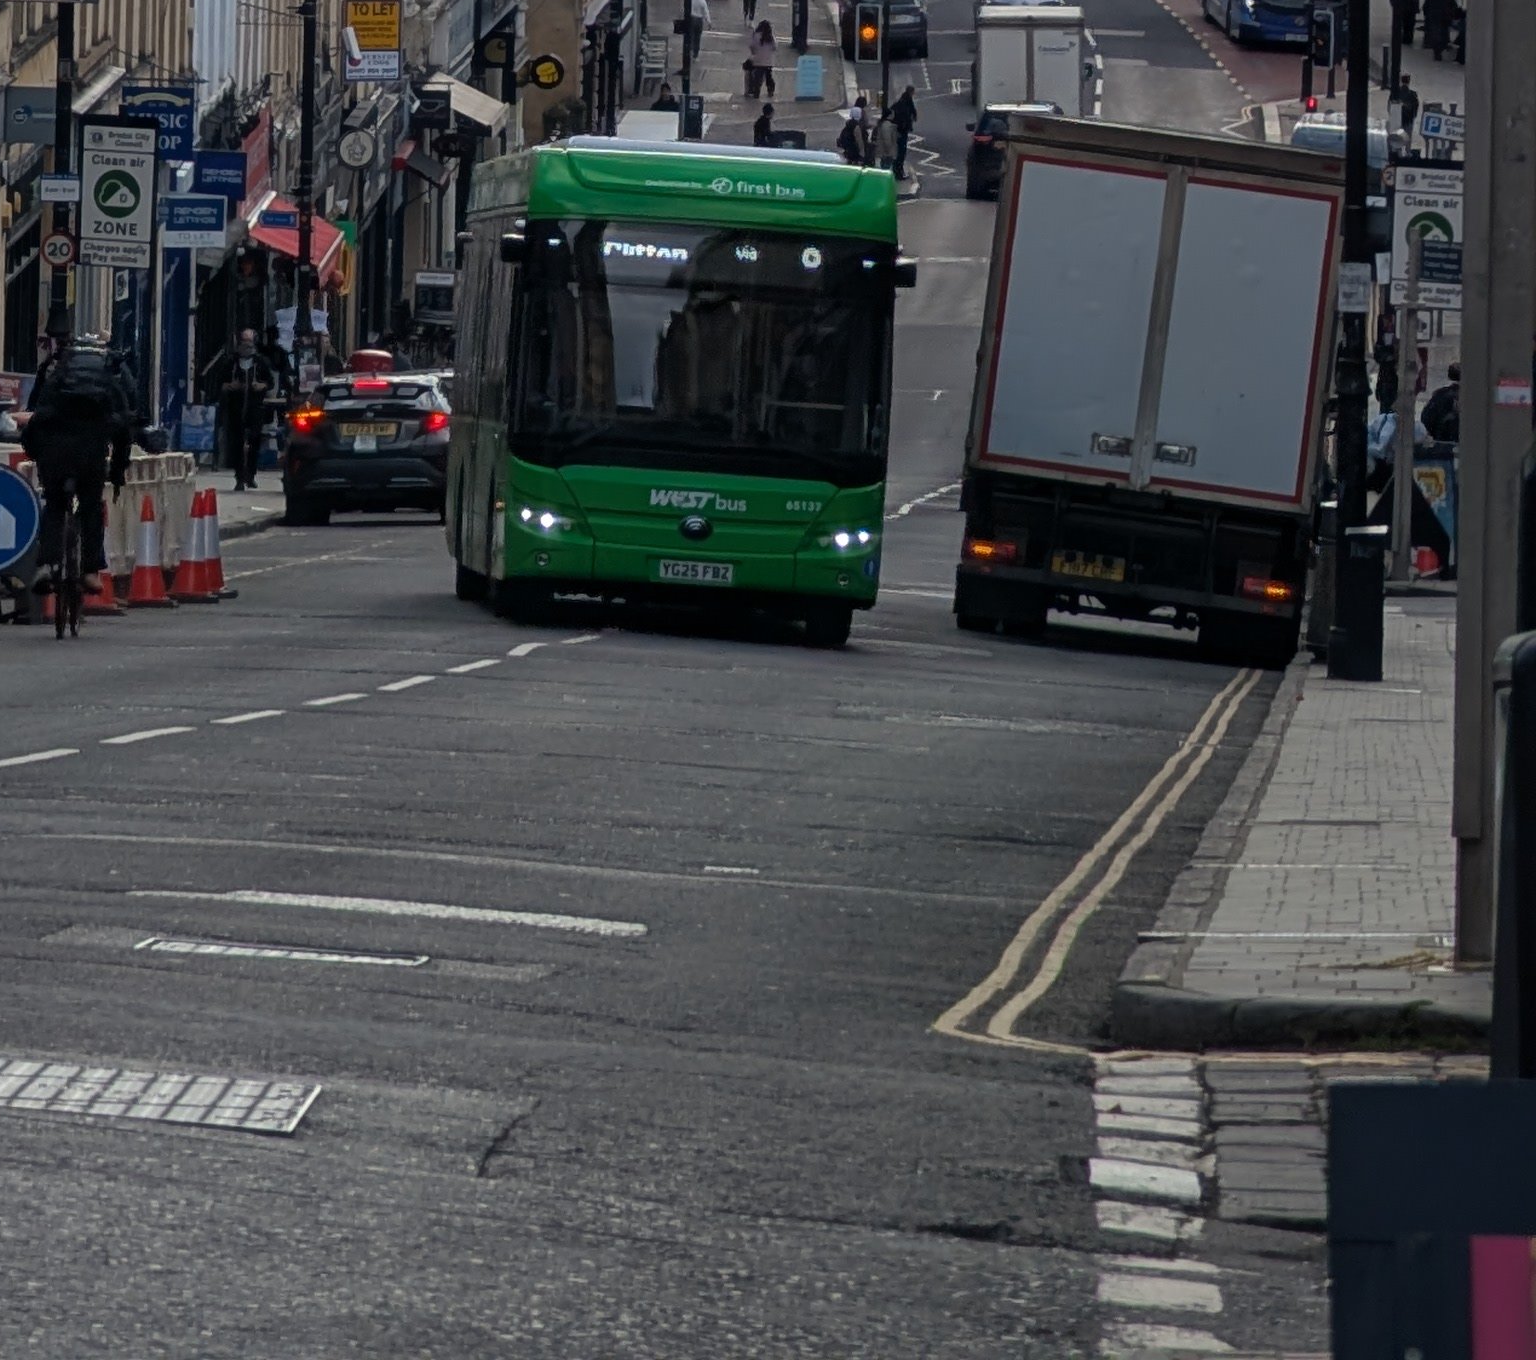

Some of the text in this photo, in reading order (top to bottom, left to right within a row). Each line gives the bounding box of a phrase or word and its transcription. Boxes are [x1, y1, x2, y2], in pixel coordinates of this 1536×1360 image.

[352, 3, 395, 16] TO LET
[108, 130, 150, 142] Bristol City
[114, 139, 144, 148] Council
[92, 154, 146, 168] Clean air
[1421, 172, 1446, 181] Bristol
[736, 180, 806, 198] first bus
[1428, 181, 1457, 190] Council
[1403, 195, 1459, 209] Clean air
[93, 221, 138, 236] ZONE
[47, 242, 70, 256] 20
[83, 242, 147, 256] Charges apply
[92, 253, 138, 263] Pay online
[1432, 284, 1462, 296] apply
[715, 493, 747, 511] bus
[662, 562, 730, 581] YG25 FBZ
